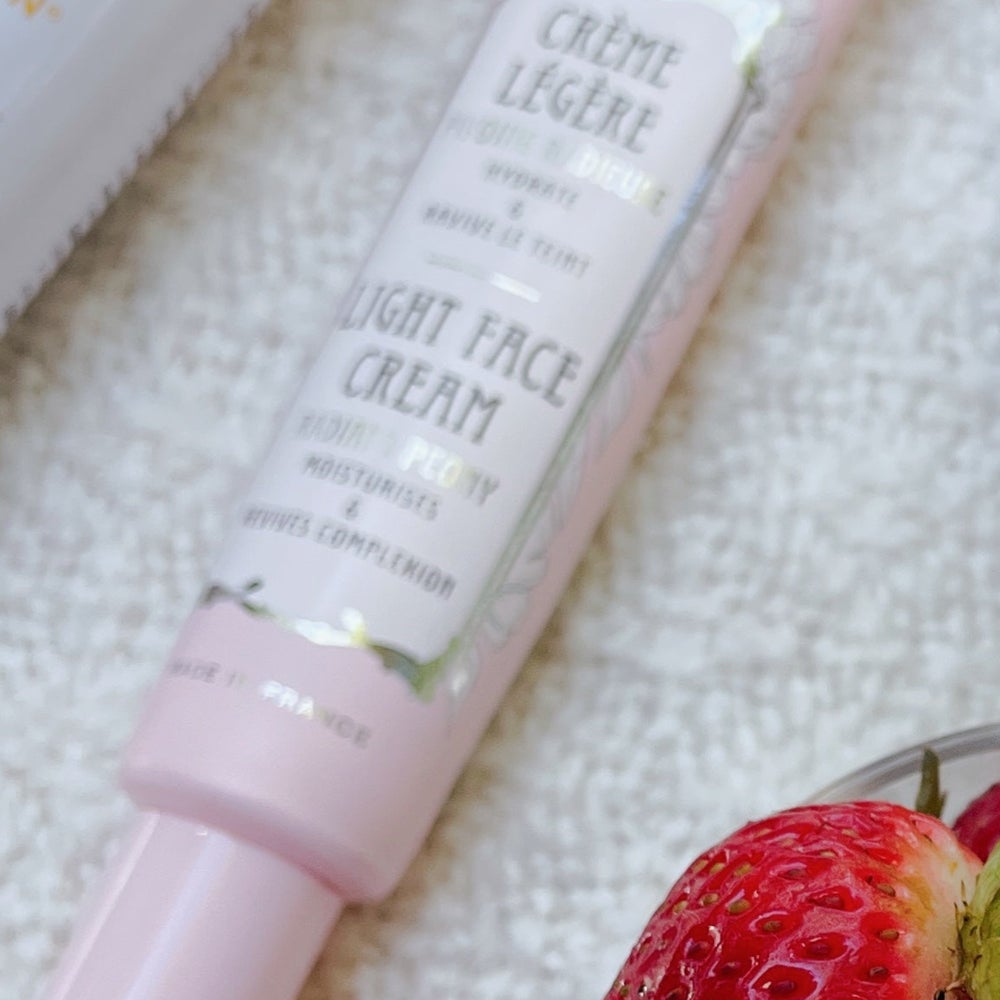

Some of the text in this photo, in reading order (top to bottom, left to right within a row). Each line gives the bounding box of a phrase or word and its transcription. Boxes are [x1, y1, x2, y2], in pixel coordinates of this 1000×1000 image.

[537, 5, 683, 89] CRÈME
[494, 60, 661, 153] LÉGÈRE
[341, 346, 504, 444] CREAM
[461, 308, 582, 409] FACE
